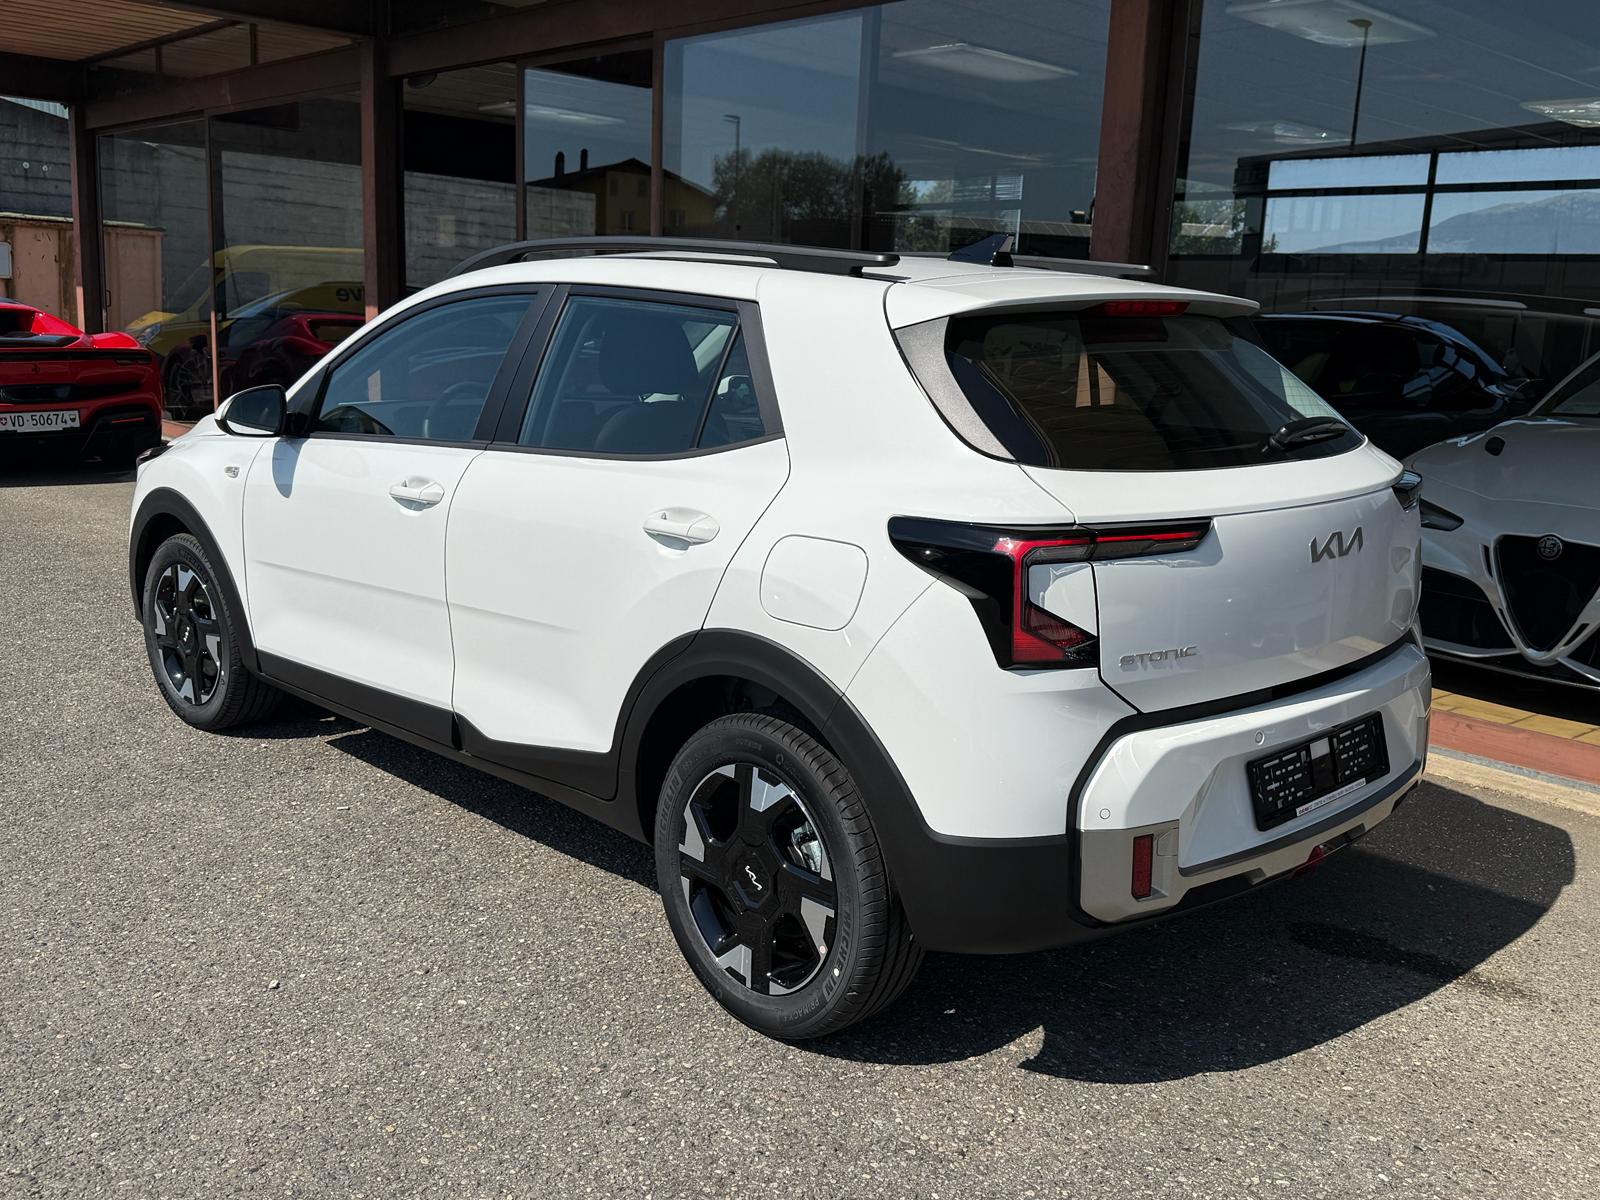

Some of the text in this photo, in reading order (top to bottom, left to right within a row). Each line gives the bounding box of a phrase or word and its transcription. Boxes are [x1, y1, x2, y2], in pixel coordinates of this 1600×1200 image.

[1309, 526, 1363, 563] KIA
[1119, 644, 1197, 668] STONIC
[824, 910, 852, 996] MICHEIN
